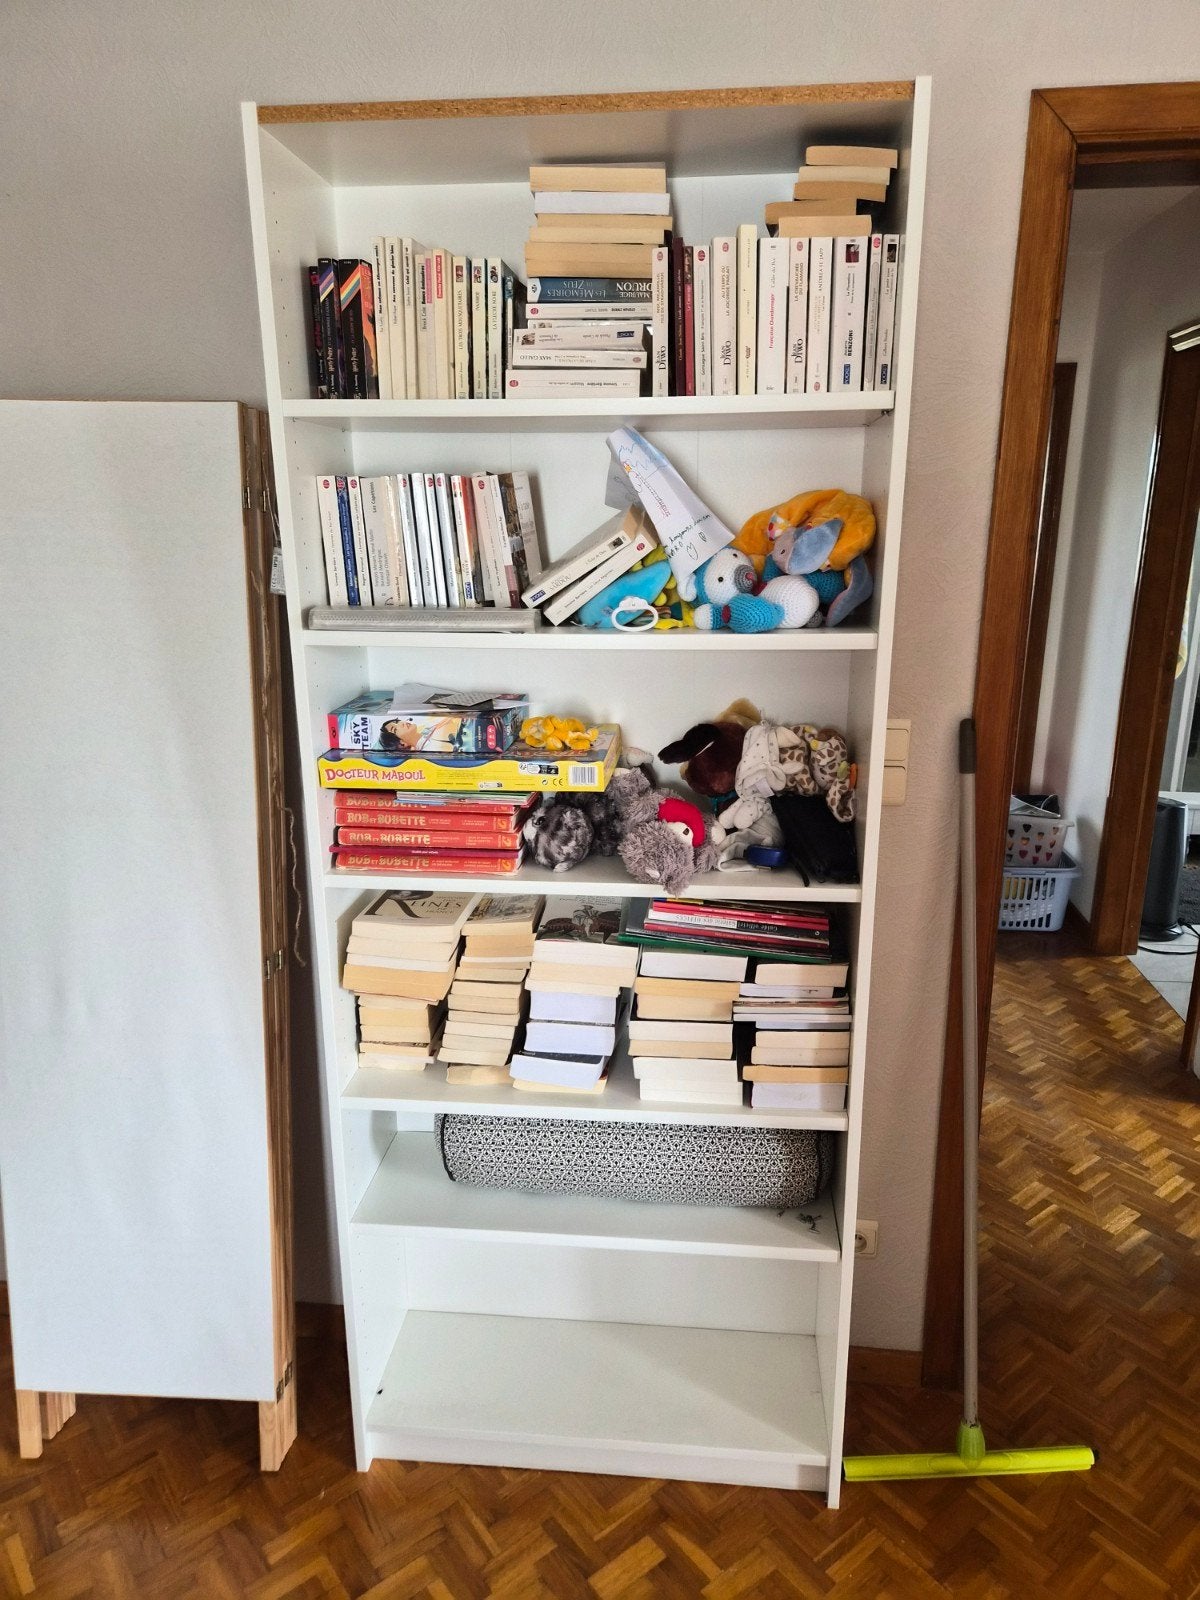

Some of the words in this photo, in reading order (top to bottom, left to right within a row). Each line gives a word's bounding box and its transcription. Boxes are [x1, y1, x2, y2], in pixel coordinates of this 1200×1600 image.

[563, 280, 585, 290] ZEUS
[616, 281, 653, 292] DRUON
[619, 291, 650, 299] MAURICE
[723, 340, 732, 366] DIWO
[794, 338, 804, 363] DIWO
[658, 345, 667, 370] DIWO
[353, 722, 361, 745] SKY
[361, 717, 370, 750] TEAM
[324, 769, 380, 782] DOCTEUR
[381, 770, 427, 782] MABOUL
[346, 796, 369, 806] BOB
[346, 812, 369, 823] BOB
[377, 813, 426, 826] BOBETTE
[349, 832, 372, 842] BOB
[380, 832, 430, 845] BOBETTE
[348, 854, 371, 865] BOB
[378, 855, 429, 867] BOBETTE
[760, 924, 779, 932] Guide
